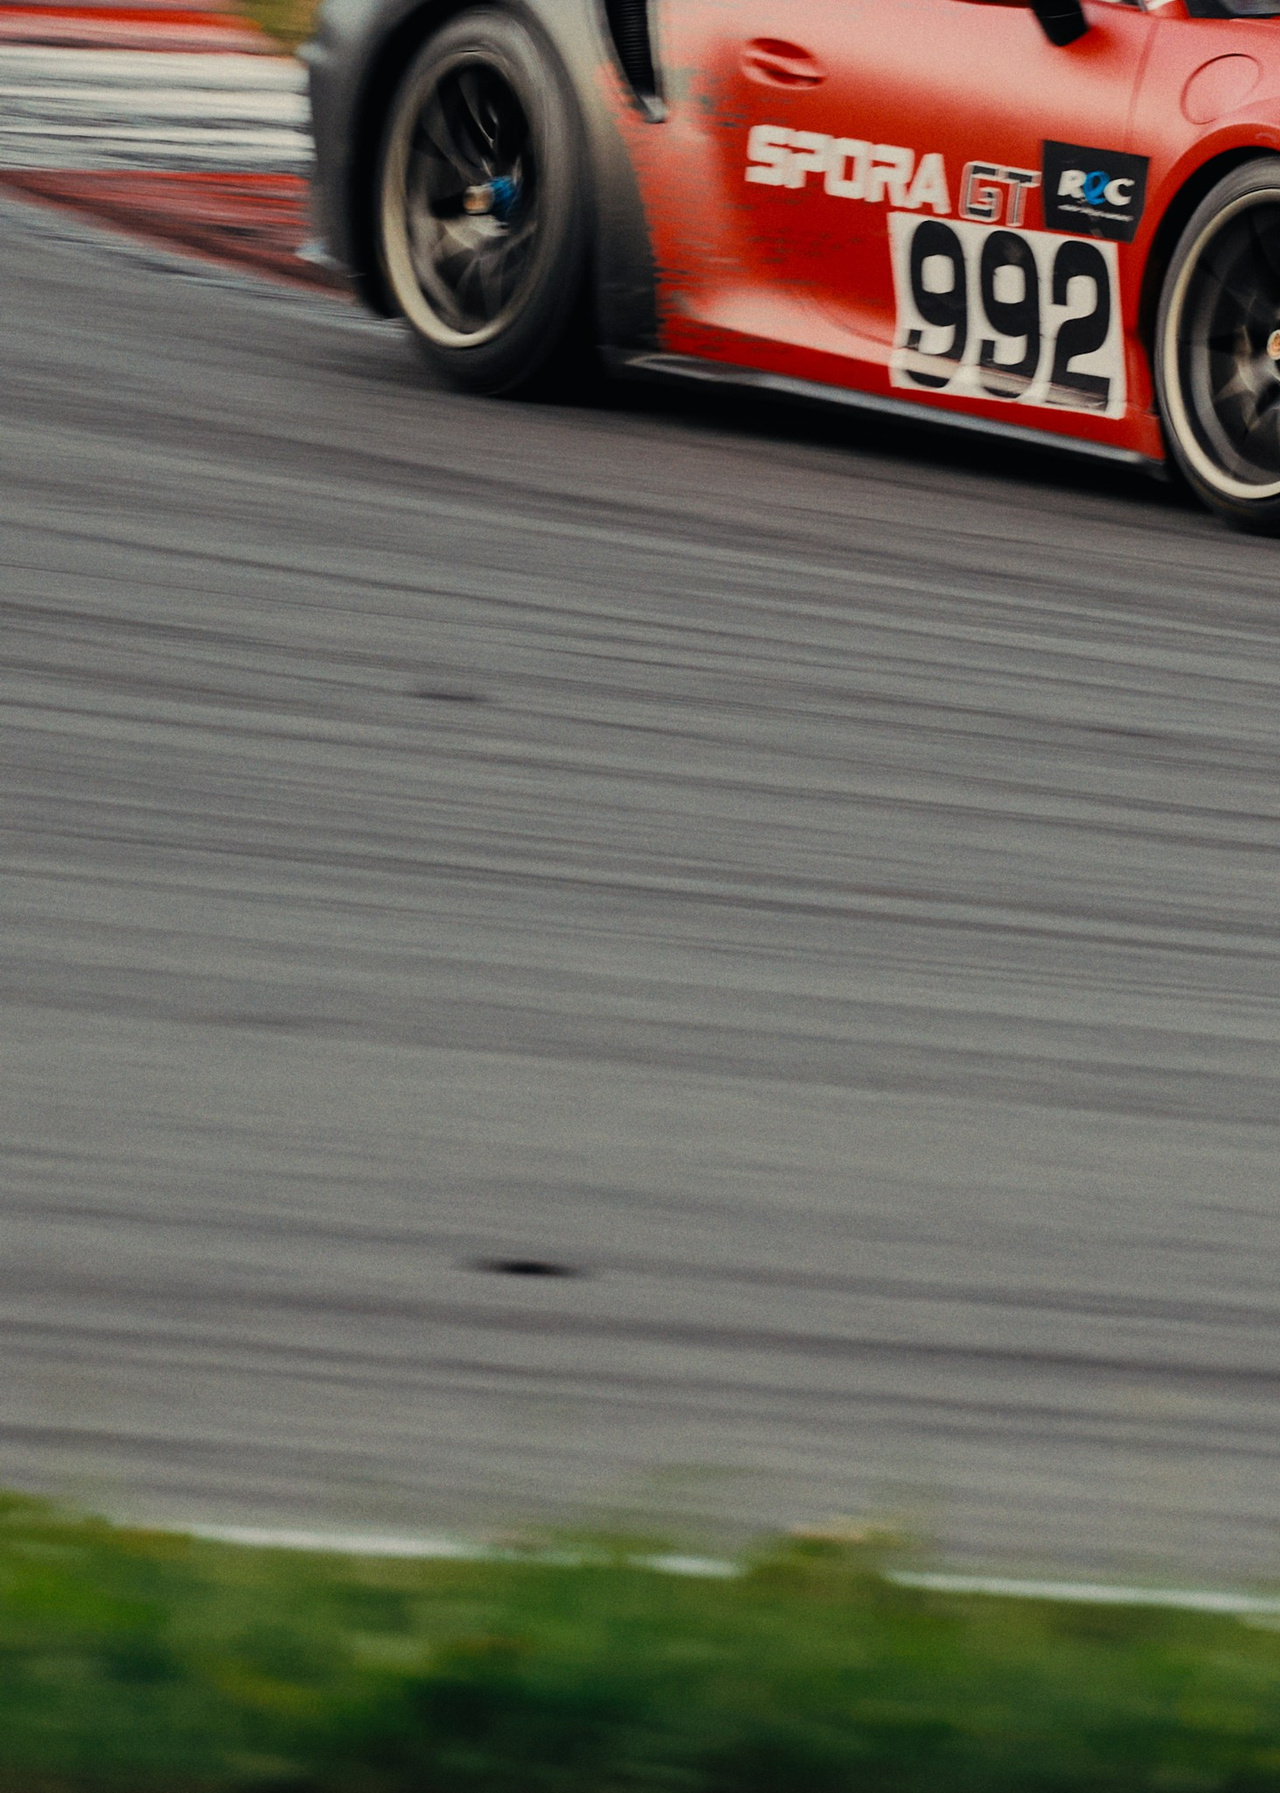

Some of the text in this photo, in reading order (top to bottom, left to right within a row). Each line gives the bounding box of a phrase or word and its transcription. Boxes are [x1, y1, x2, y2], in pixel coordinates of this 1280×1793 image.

[745, 124, 1042, 227] SPORA GT
[904, 219, 1111, 412] 992
